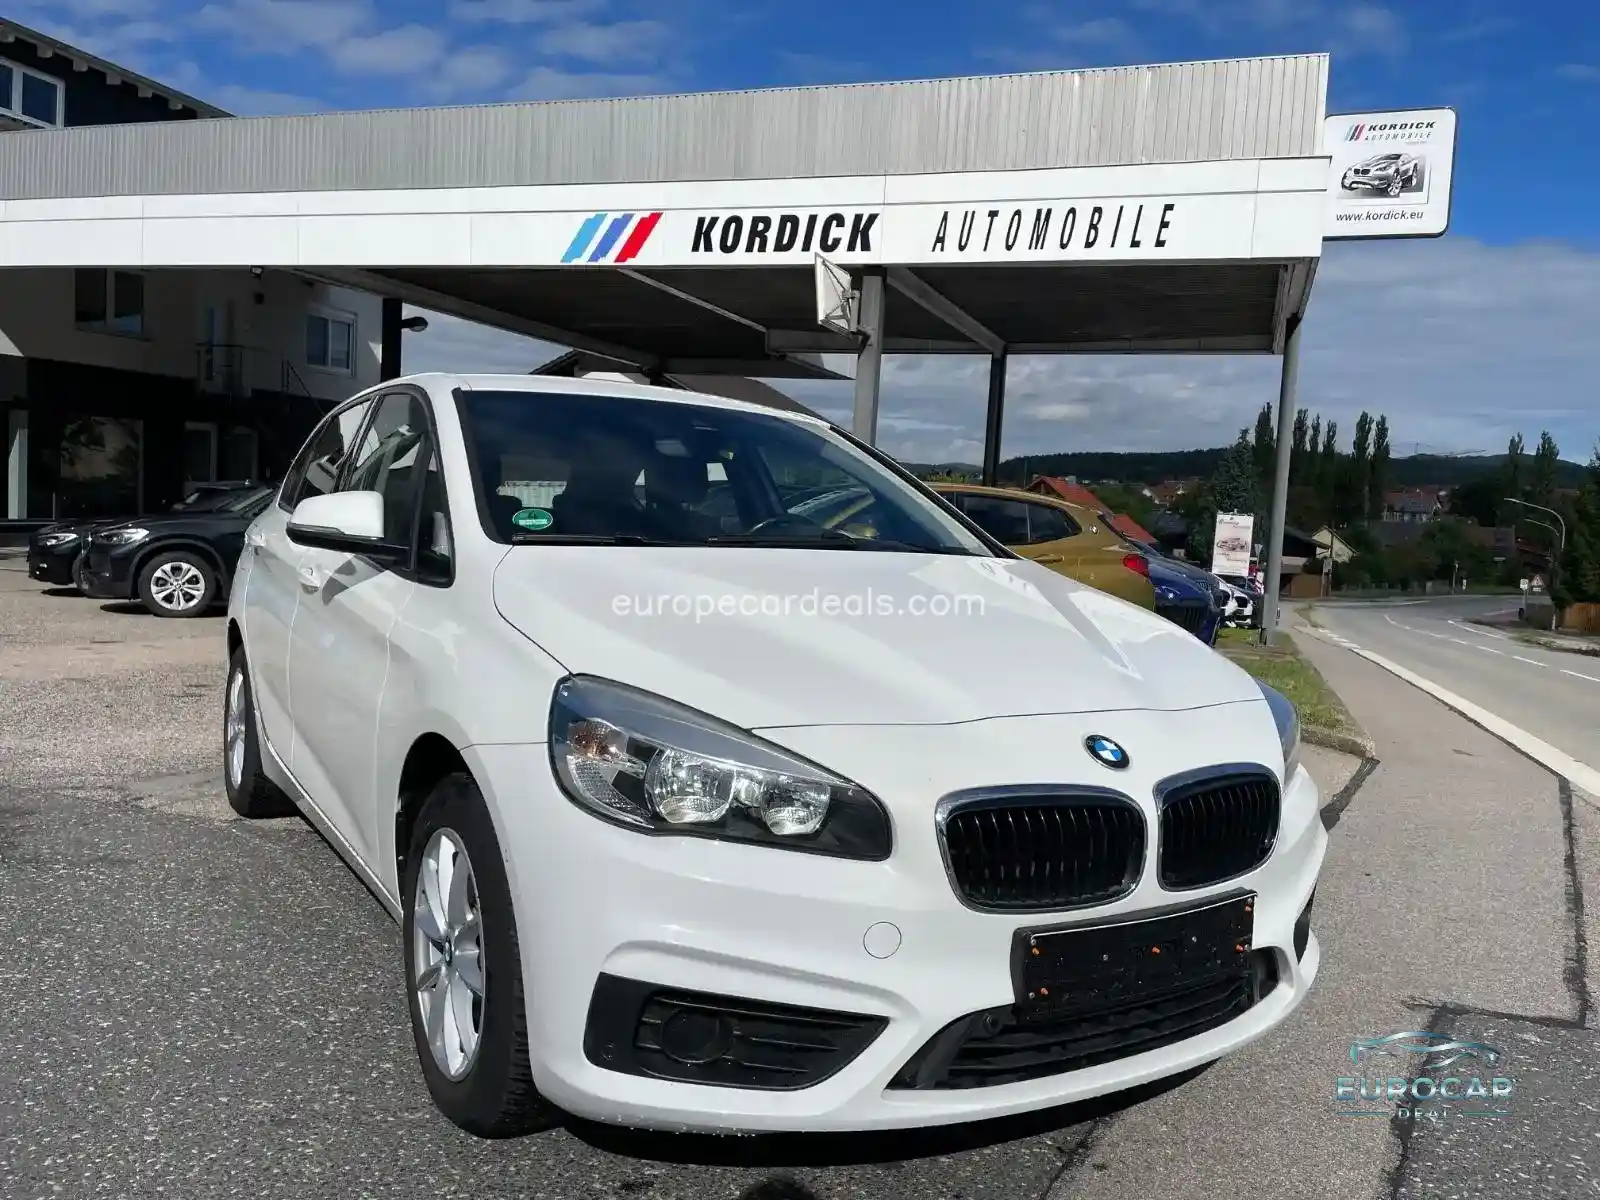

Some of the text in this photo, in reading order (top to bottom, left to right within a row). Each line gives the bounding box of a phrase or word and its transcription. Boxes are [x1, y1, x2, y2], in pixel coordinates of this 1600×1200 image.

[1368, 121, 1437, 132] KORDICK
[1365, 132, 1432, 142] AUTOMOBILE
[1336, 210, 1424, 222] www.kordick.eu
[691, 204, 1175, 253] KORDICK AUTOMOBILE
